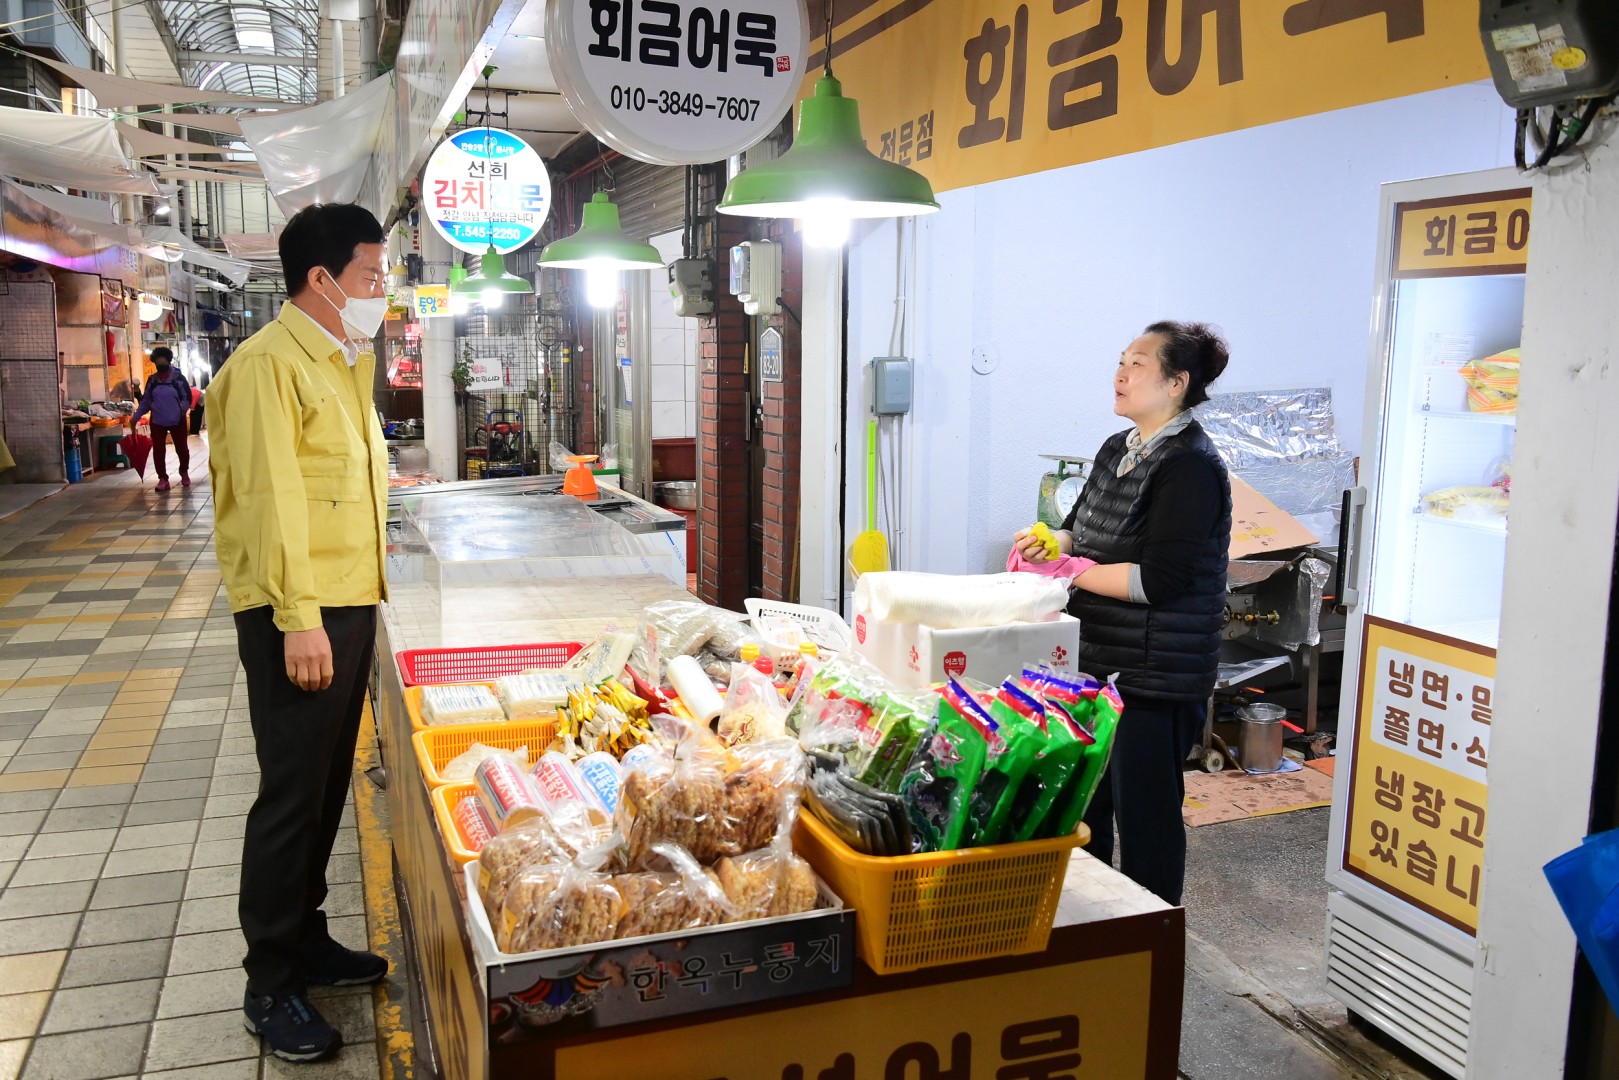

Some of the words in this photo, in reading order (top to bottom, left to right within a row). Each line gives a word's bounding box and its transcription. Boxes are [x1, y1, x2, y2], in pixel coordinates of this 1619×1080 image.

[588, 0, 777, 77] 회금어묵
[610, 84, 761, 122] 010-3849-7607
[467, 160, 508, 181] 선희
[879, 108, 935, 168] 전문점
[1374, 765, 1486, 849] 냉장고
[1369, 819, 1480, 907] 있습니
[629, 934, 841, 1003] 한옥누룽지
